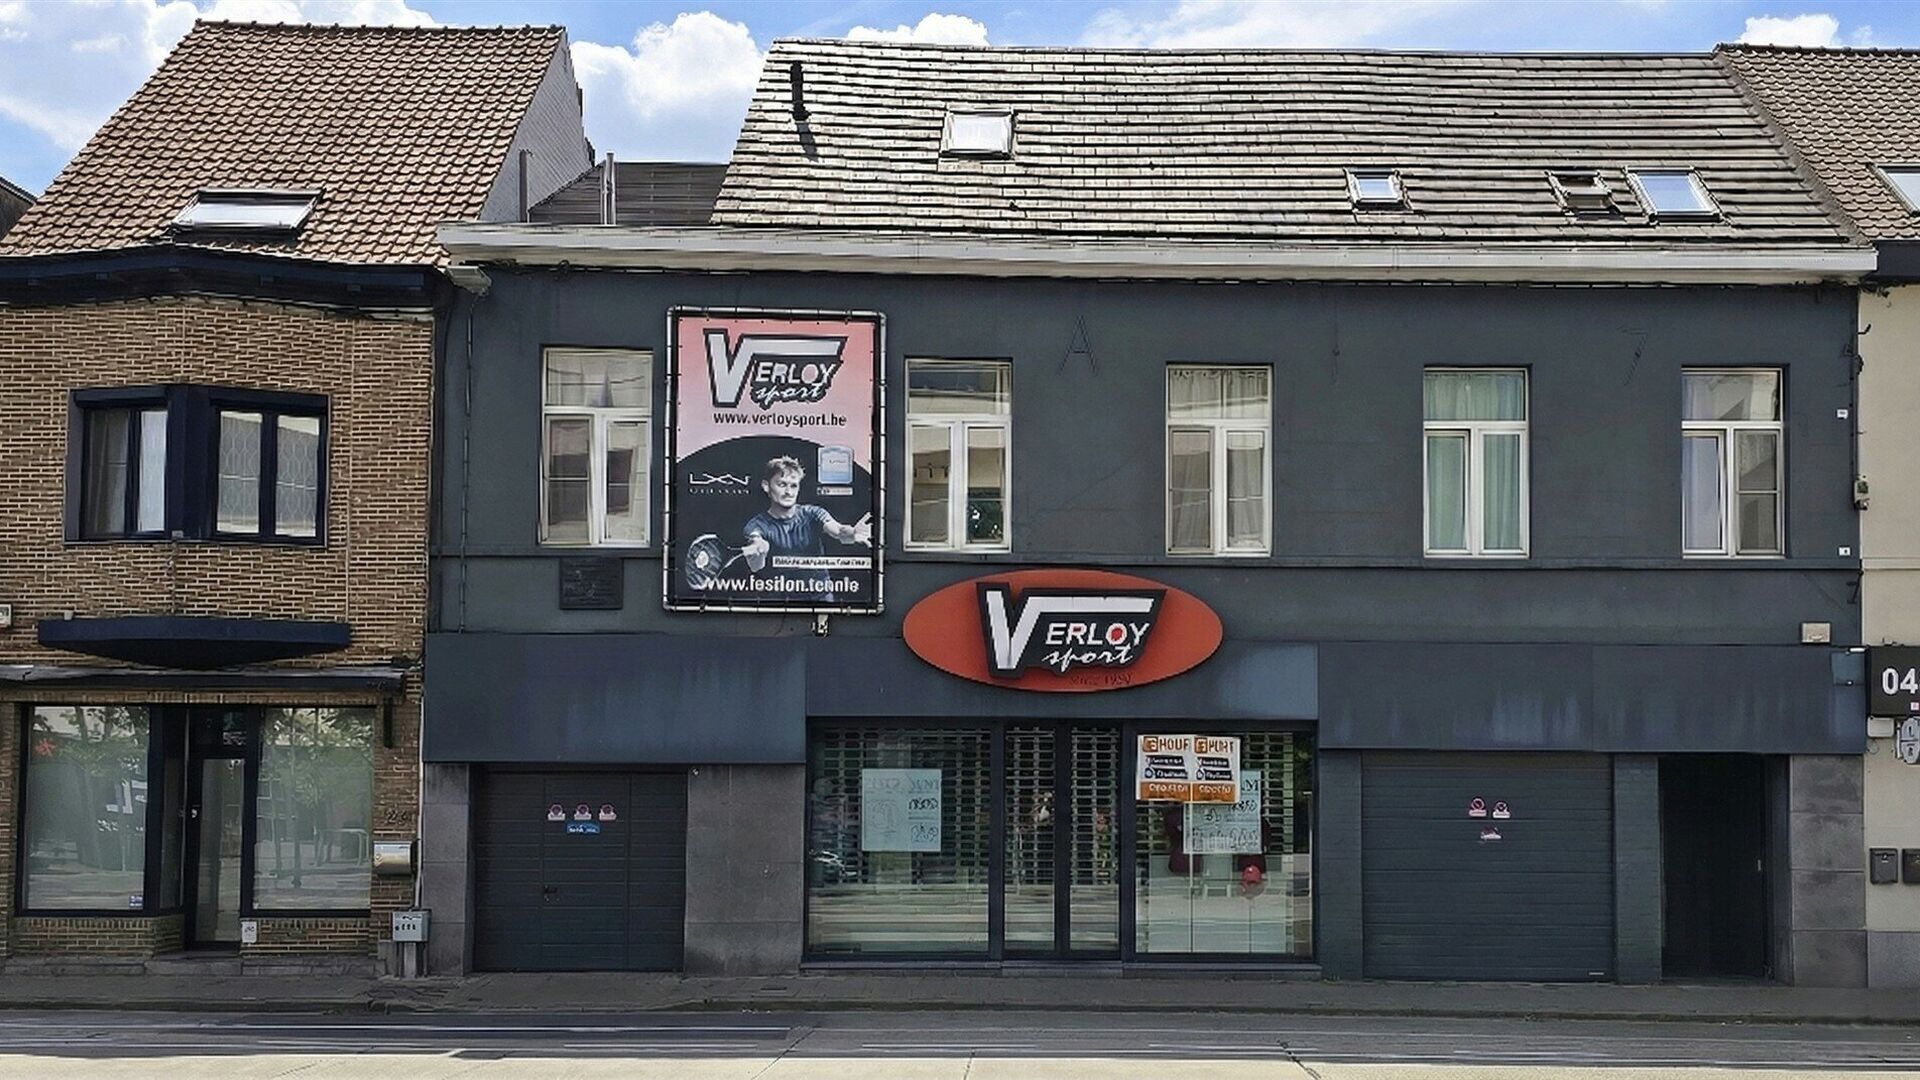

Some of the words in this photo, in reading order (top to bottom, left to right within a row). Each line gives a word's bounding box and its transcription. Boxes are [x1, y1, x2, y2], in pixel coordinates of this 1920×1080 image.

[705, 331, 842, 404] VERLOY
[754, 382, 824, 406] sport
[985, 589, 1155, 671] VERLOY
[1042, 645, 1136, 673] sport
